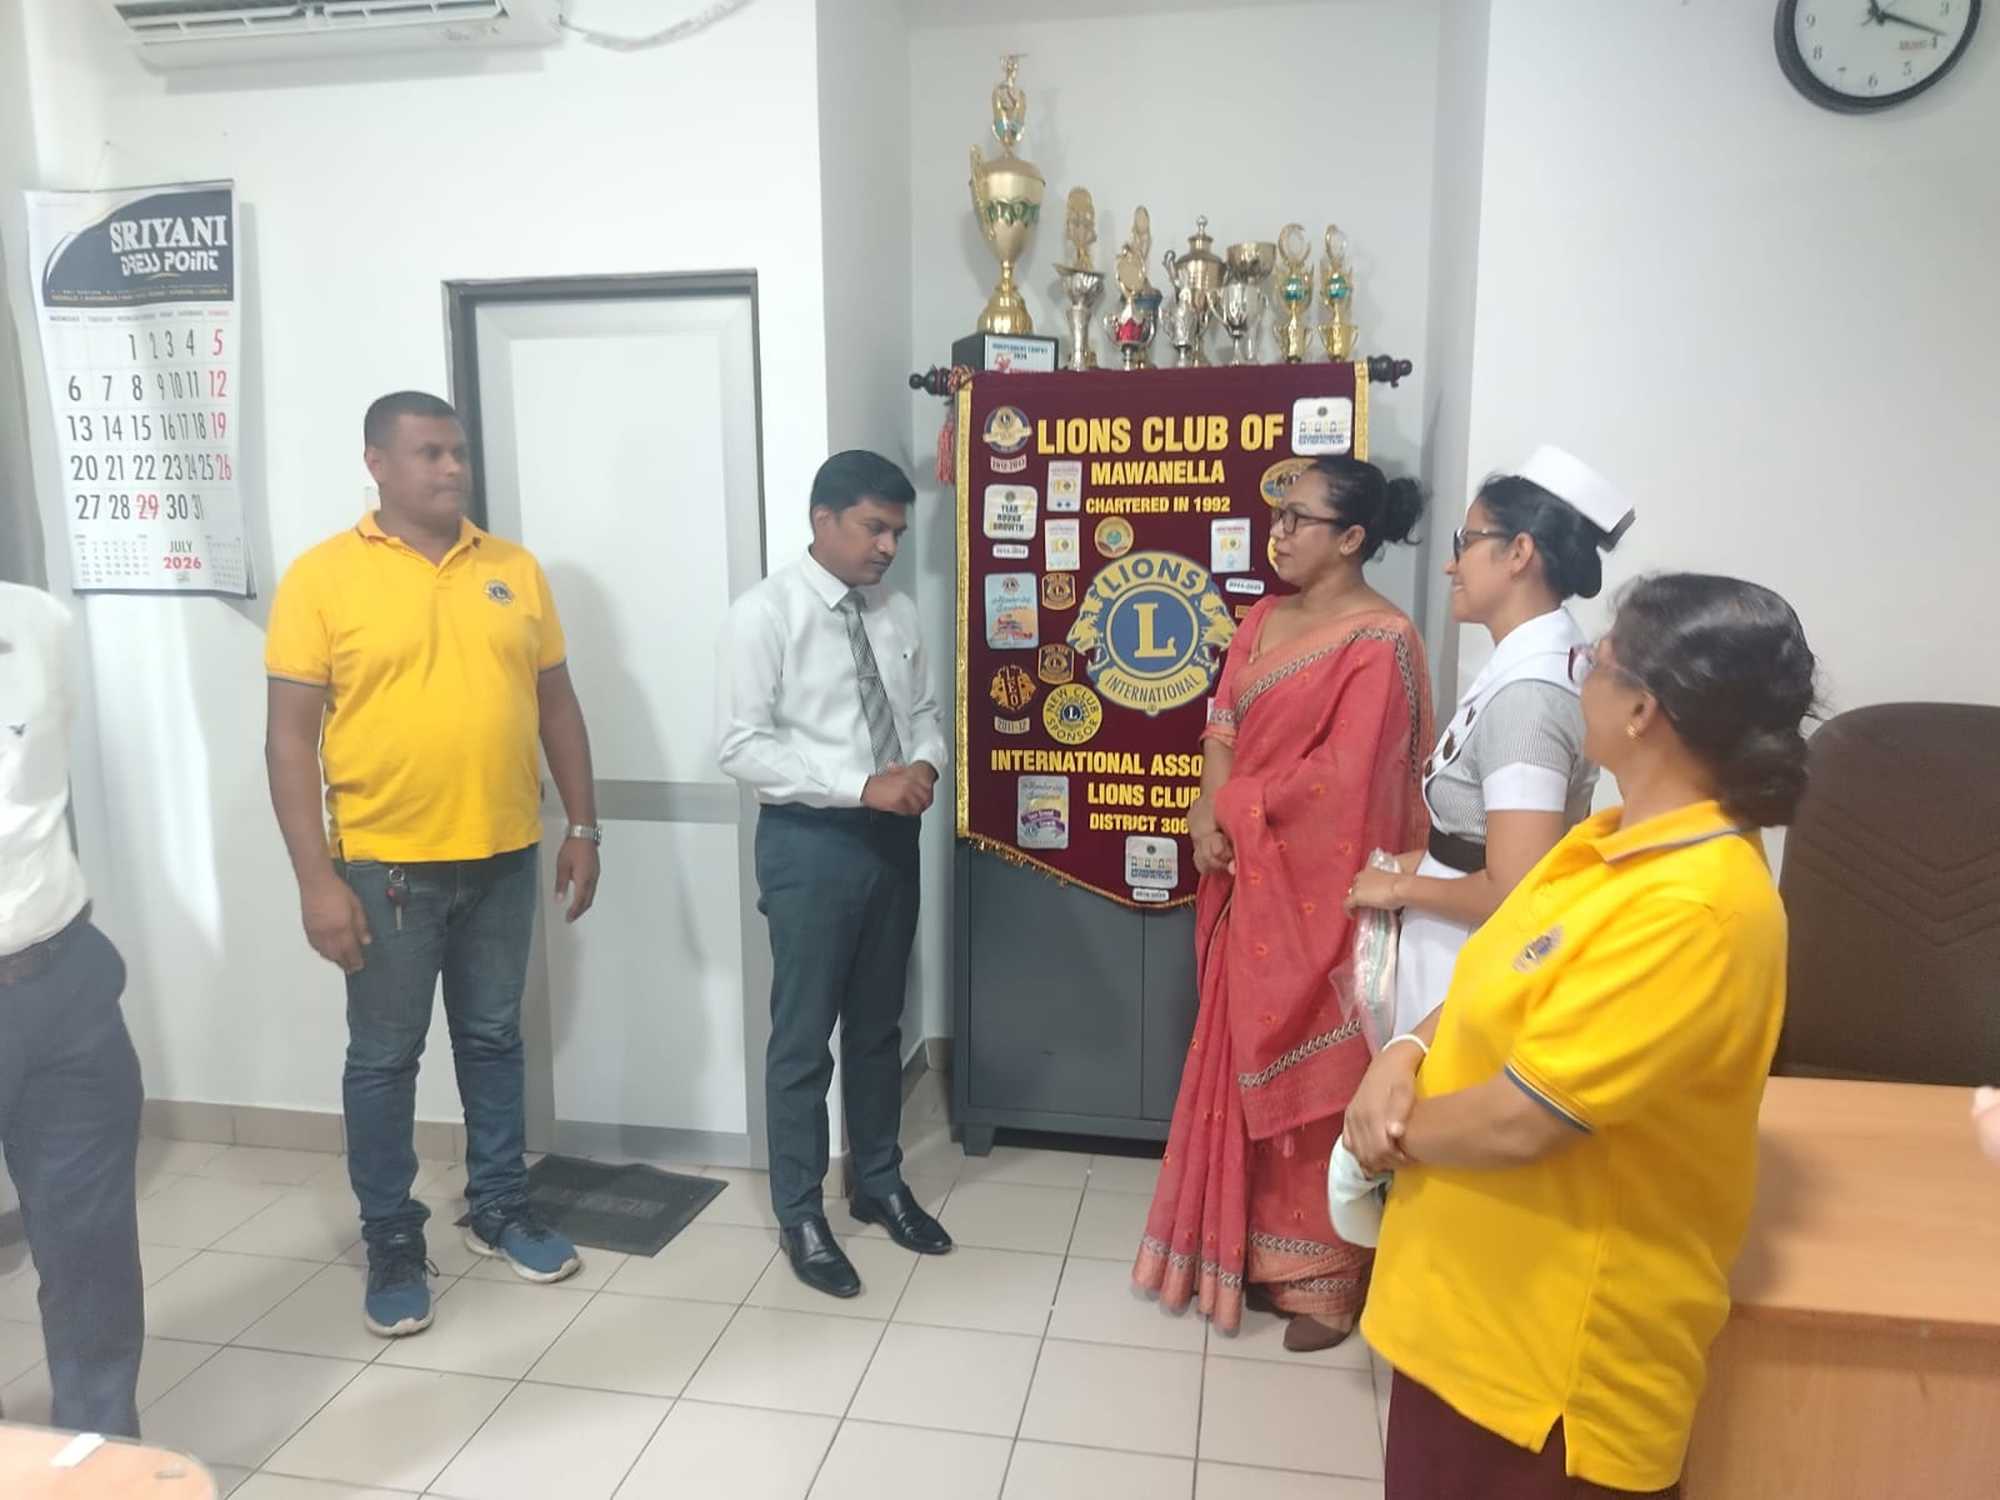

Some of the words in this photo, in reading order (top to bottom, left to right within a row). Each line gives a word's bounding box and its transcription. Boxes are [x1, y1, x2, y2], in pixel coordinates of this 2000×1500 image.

[1806, 14, 1816, 29] 9
[1867, 72, 1879, 88] 6
[1903, 61, 1912, 76] 5
[109, 215, 228, 253] SRIYANI
[120, 251, 161, 277] DRESS
[128, 334, 137, 361] 1
[149, 332, 159, 360] 2
[165, 331, 175, 358] 3
[185, 329, 195, 357] 4
[212, 328, 224, 356] 5
[67, 375, 82, 402] 6
[102, 375, 113, 402] 7
[132, 374, 144, 402] 8
[156, 373, 166, 401] 9
[168, 371, 184, 399] 10
[186, 370, 201, 399] 11
[209, 369, 228, 399] 12
[67, 415, 94, 442] 13
[103, 415, 123, 441] 14
[131, 414, 152, 441] 15
[160, 413, 176, 441] 16
[176, 413, 189, 440] 17
[191, 412, 207, 440] 18
[210, 411, 227, 440] 19
[1037, 417, 1131, 455] LIONS
[1142, 415, 1229, 452] CLUB
[1240, 413, 1285, 451] OF
[69, 454, 99, 481] 20
[104, 454, 125, 481] 21
[132, 454, 157, 481] 22
[162, 454, 184, 481] 23
[184, 454, 198, 481] 24
[197, 453, 215, 481] 25
[215, 453, 233, 481] 26
[1090, 460, 1226, 486] MAWANELLA
[75, 494, 101, 521] 27
[108, 494, 131, 521] 28
[135, 494, 160, 521] 29
[165, 494, 189, 521] 30
[190, 494, 204, 522] 31
[1085, 497, 1170, 514] CHARTERED
[1173, 497, 1189, 513] IN
[1193, 496, 1231, 512] 1992
[993, 522, 1025, 532] GROWTH
[169, 540, 193, 554] JULY
[163, 556, 202, 570] 2026
[1100, 558, 1201, 593] LIONS
[1133, 603, 1177, 658] L
[1006, 666, 1019, 707] LEO
[1106, 673, 1201, 703] INTERNATIONAL
[1046, 687, 1068, 713] NEW
[1073, 687, 1100, 713] CLUB
[1046, 718, 1098, 741] SPONSOR
[990, 749, 1145, 776] INTERNATIONAL
[1088, 782, 1145, 807] LIONS
[1089, 812, 1157, 832] DISTRICT
